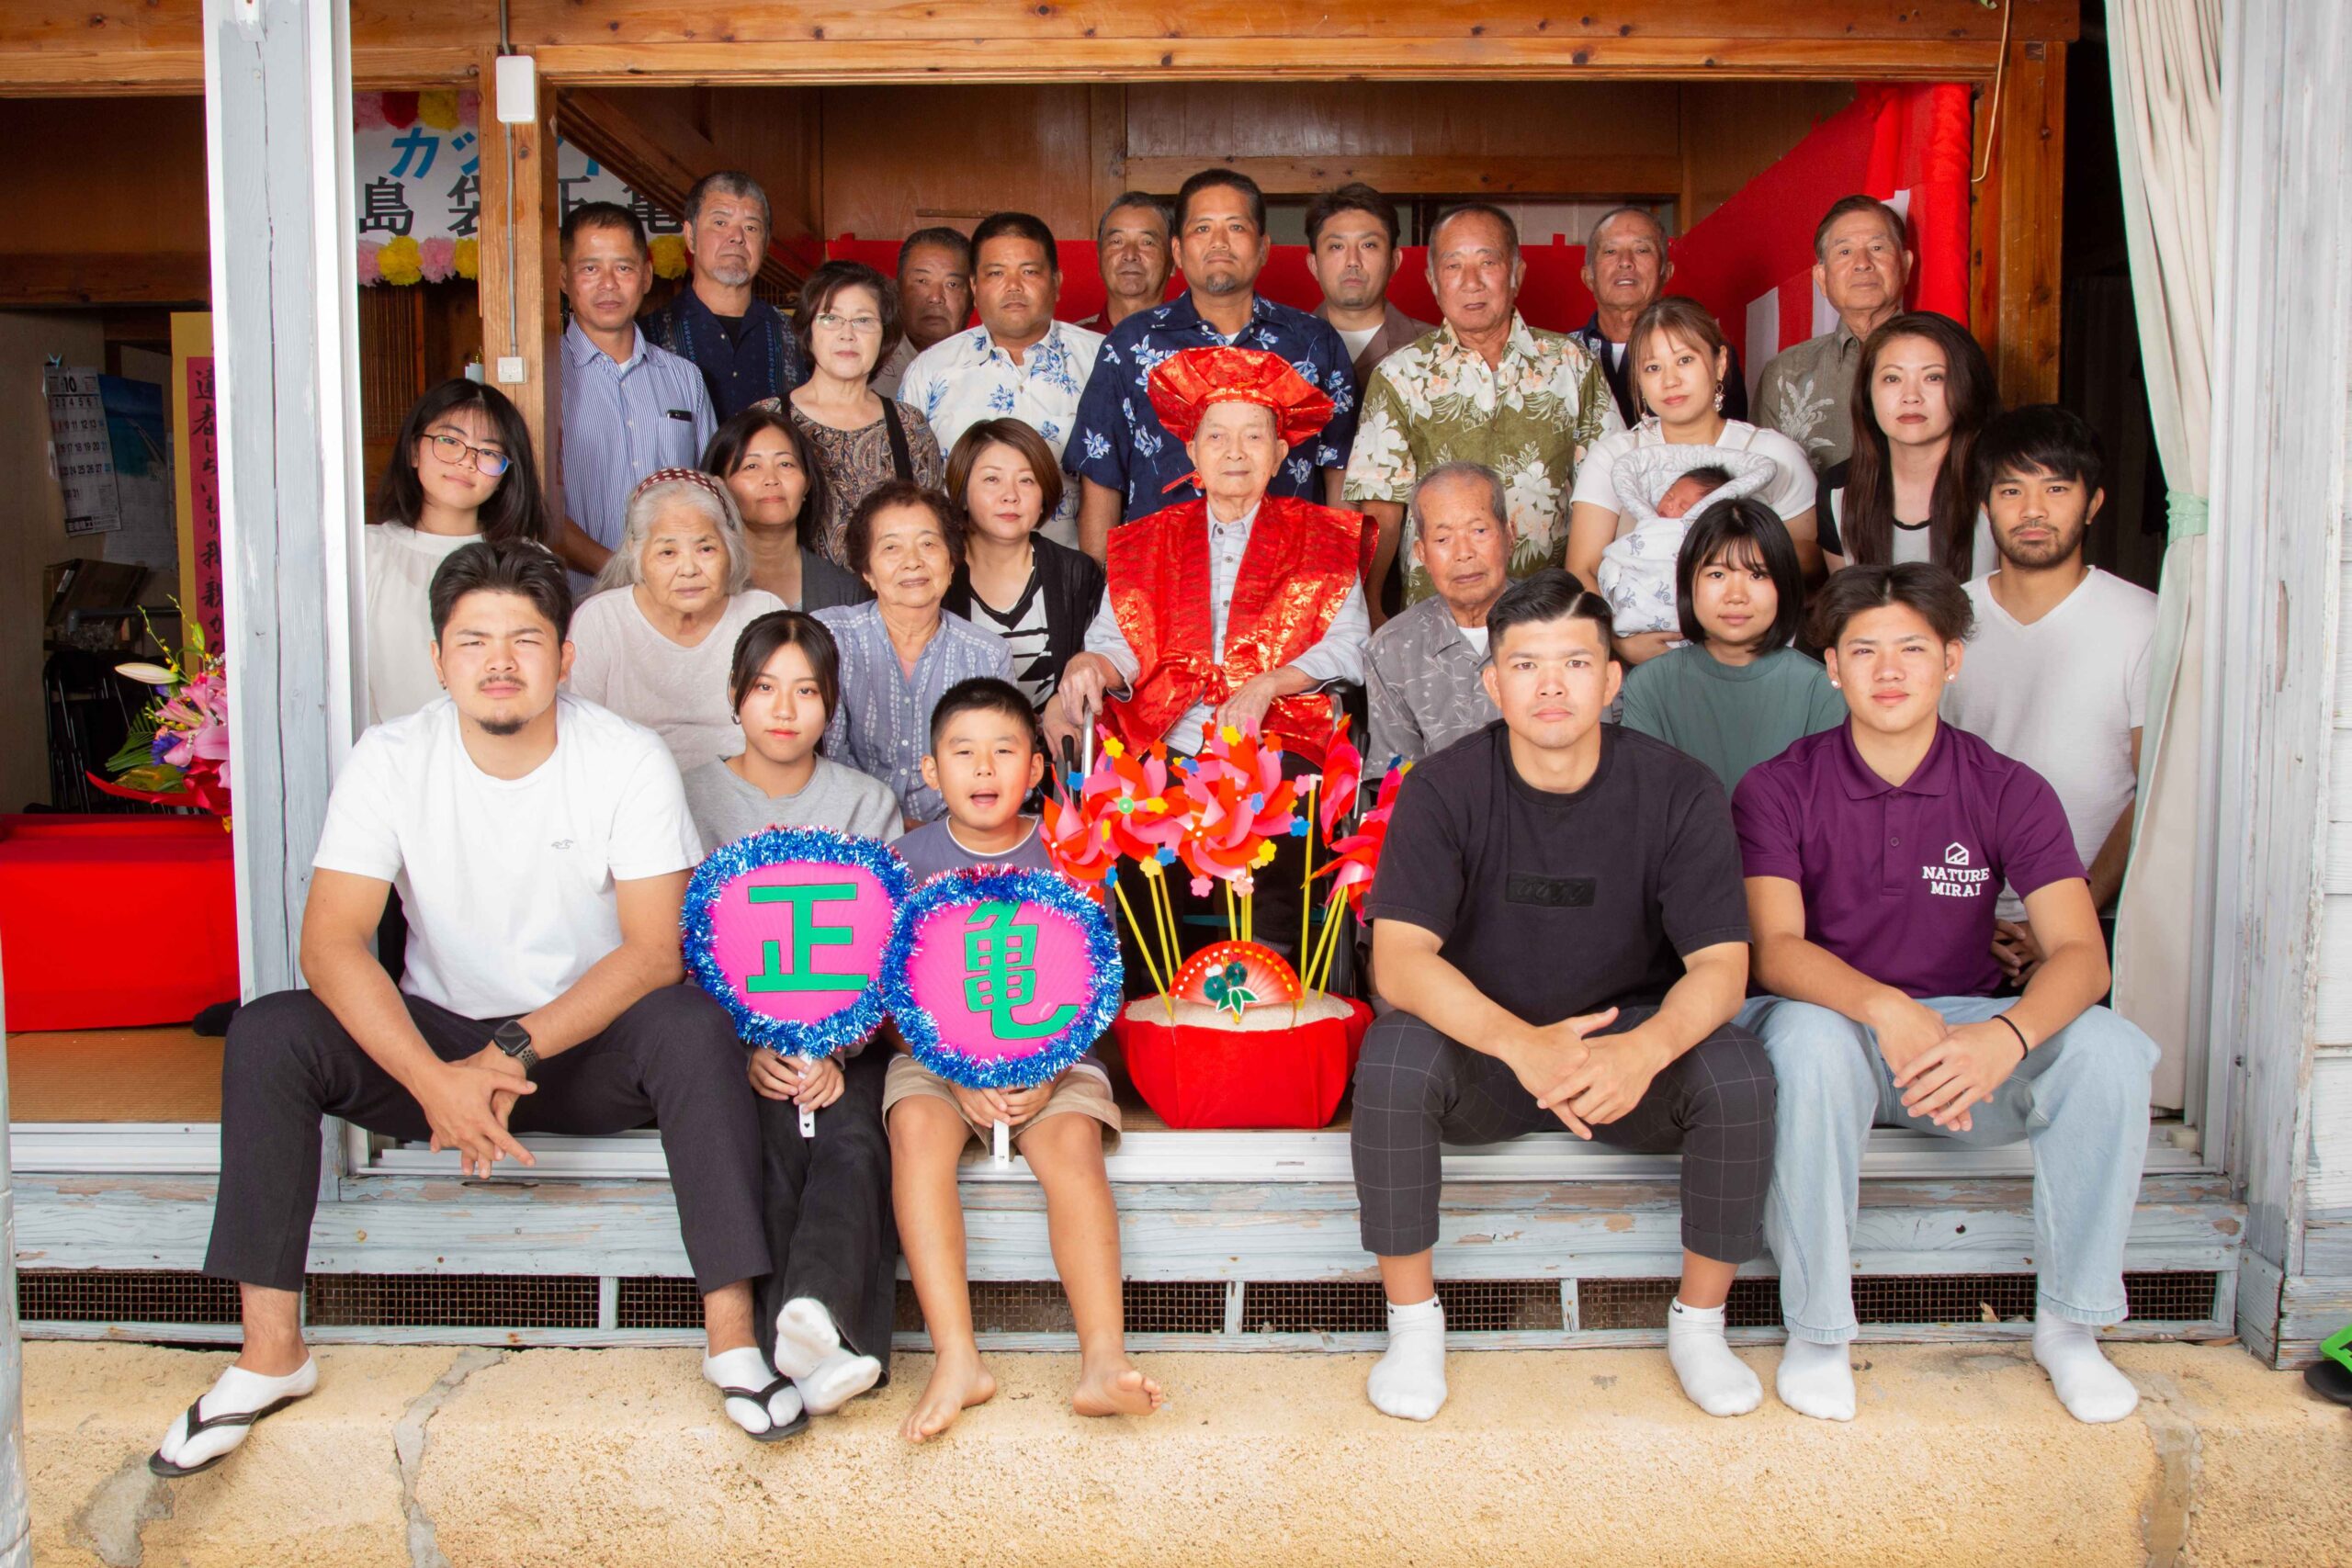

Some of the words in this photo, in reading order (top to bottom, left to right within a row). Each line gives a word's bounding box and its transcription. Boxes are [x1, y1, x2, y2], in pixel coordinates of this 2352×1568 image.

[62, 377, 77, 392] 10
[78, 397, 84, 406] 5
[81, 420, 88, 429] 12
[89, 419, 96, 428] 13
[84, 442, 91, 451] 19
[93, 442, 100, 451] 20
[78, 465, 85, 474] 25
[96, 463, 102, 473] 27
[1922, 866, 1990, 882] NATURE
[1930, 881, 1982, 897] MIRAI
[746, 883, 869, 992] 正
[964, 900, 1080, 1040] 亀
